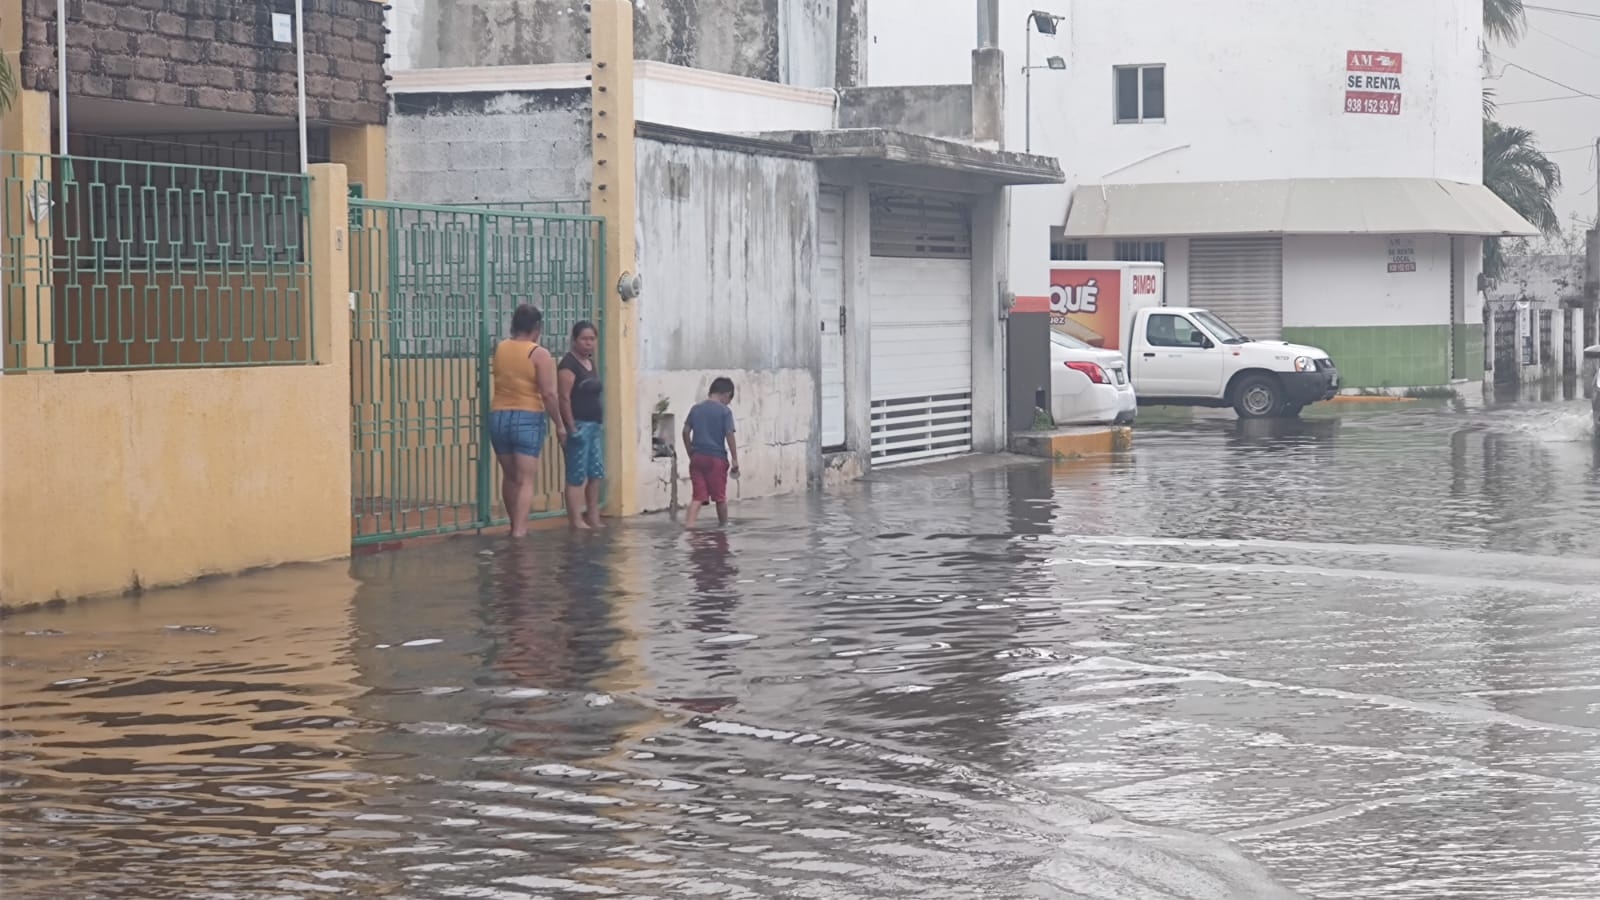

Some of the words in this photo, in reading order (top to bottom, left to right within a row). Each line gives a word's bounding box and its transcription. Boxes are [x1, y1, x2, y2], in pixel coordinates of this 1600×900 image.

[1349, 54, 1373, 66] AM
[1347, 75, 1363, 88] SE
[1366, 76, 1401, 90] RENTA
[1346, 98, 1362, 112] 938
[1364, 99, 1378, 113] 152
[1133, 275, 1155, 294] BIMBO
